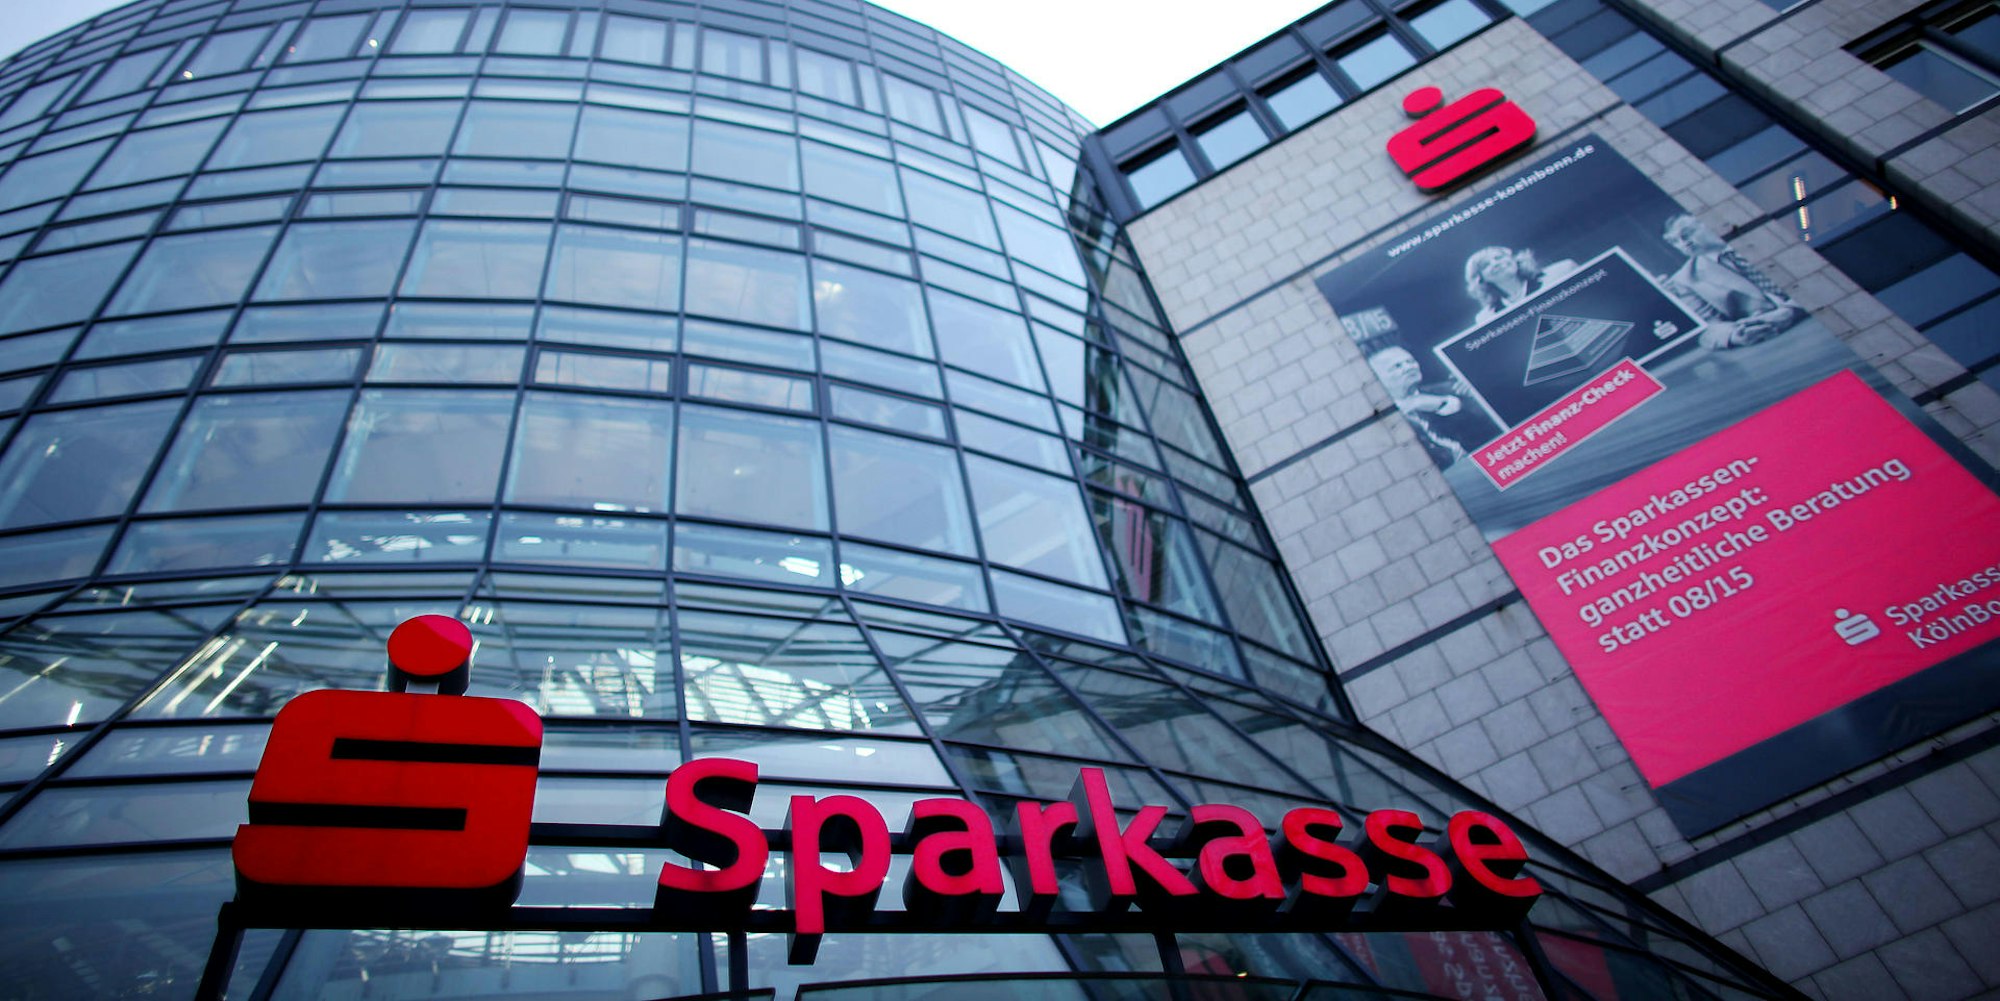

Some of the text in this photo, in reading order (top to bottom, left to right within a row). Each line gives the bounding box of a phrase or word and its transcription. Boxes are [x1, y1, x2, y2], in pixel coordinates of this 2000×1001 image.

[1387, 144, 1595, 258] www.sparkasse-koelnbonn.de
[1485, 367, 1636, 467] Jetzt Finanz-Check
[1497, 430, 1568, 481] machen!
[1538, 456, 1759, 569] Das Sparkassen-
[1556, 486, 1769, 596] Finanzkonzept:
[1578, 458, 1913, 628] ganzheitliche Beratung
[1598, 565, 1755, 654] statt 08/15
[1884, 562, 2000, 626] Sparkass
[657, 756, 1544, 935] Sparkasse
